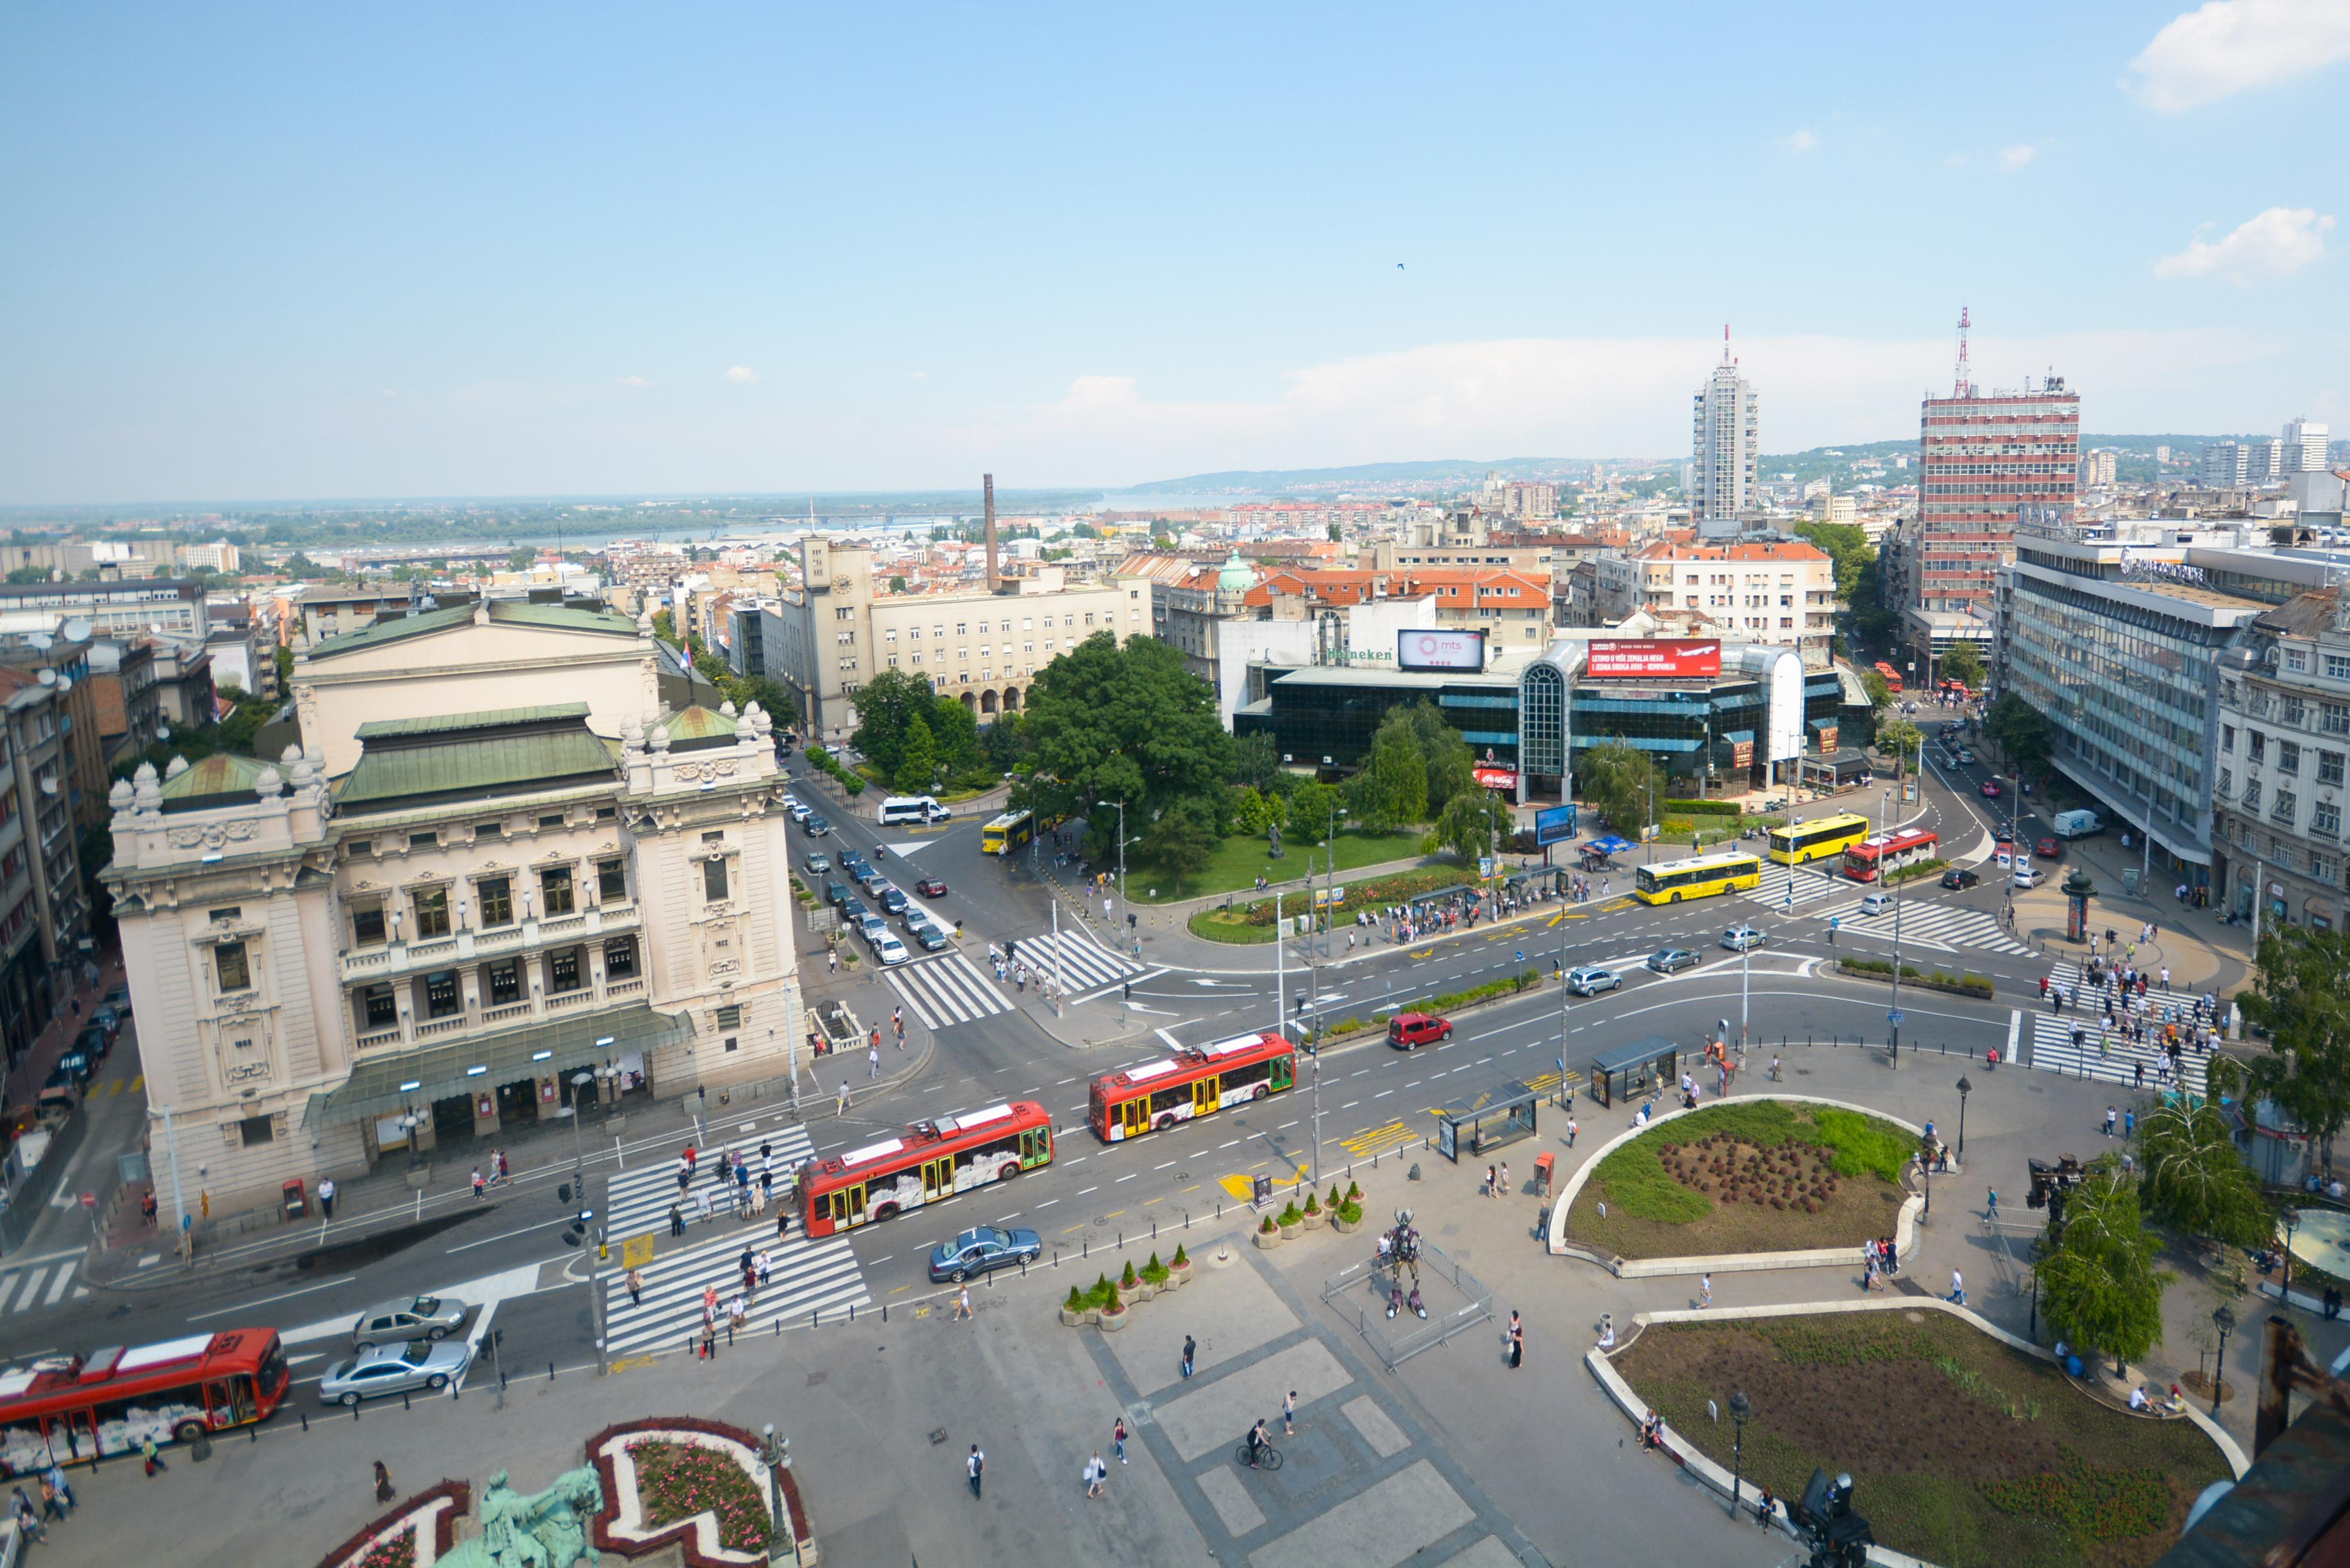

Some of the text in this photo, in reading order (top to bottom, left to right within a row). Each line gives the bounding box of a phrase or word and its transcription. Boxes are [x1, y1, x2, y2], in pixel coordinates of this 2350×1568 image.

[1441, 641, 1462, 650] mts
[1328, 647, 1392, 661] Heineken
[1592, 654, 1609, 663] LETIMO
[1615, 653, 1626, 662] VIŠE
